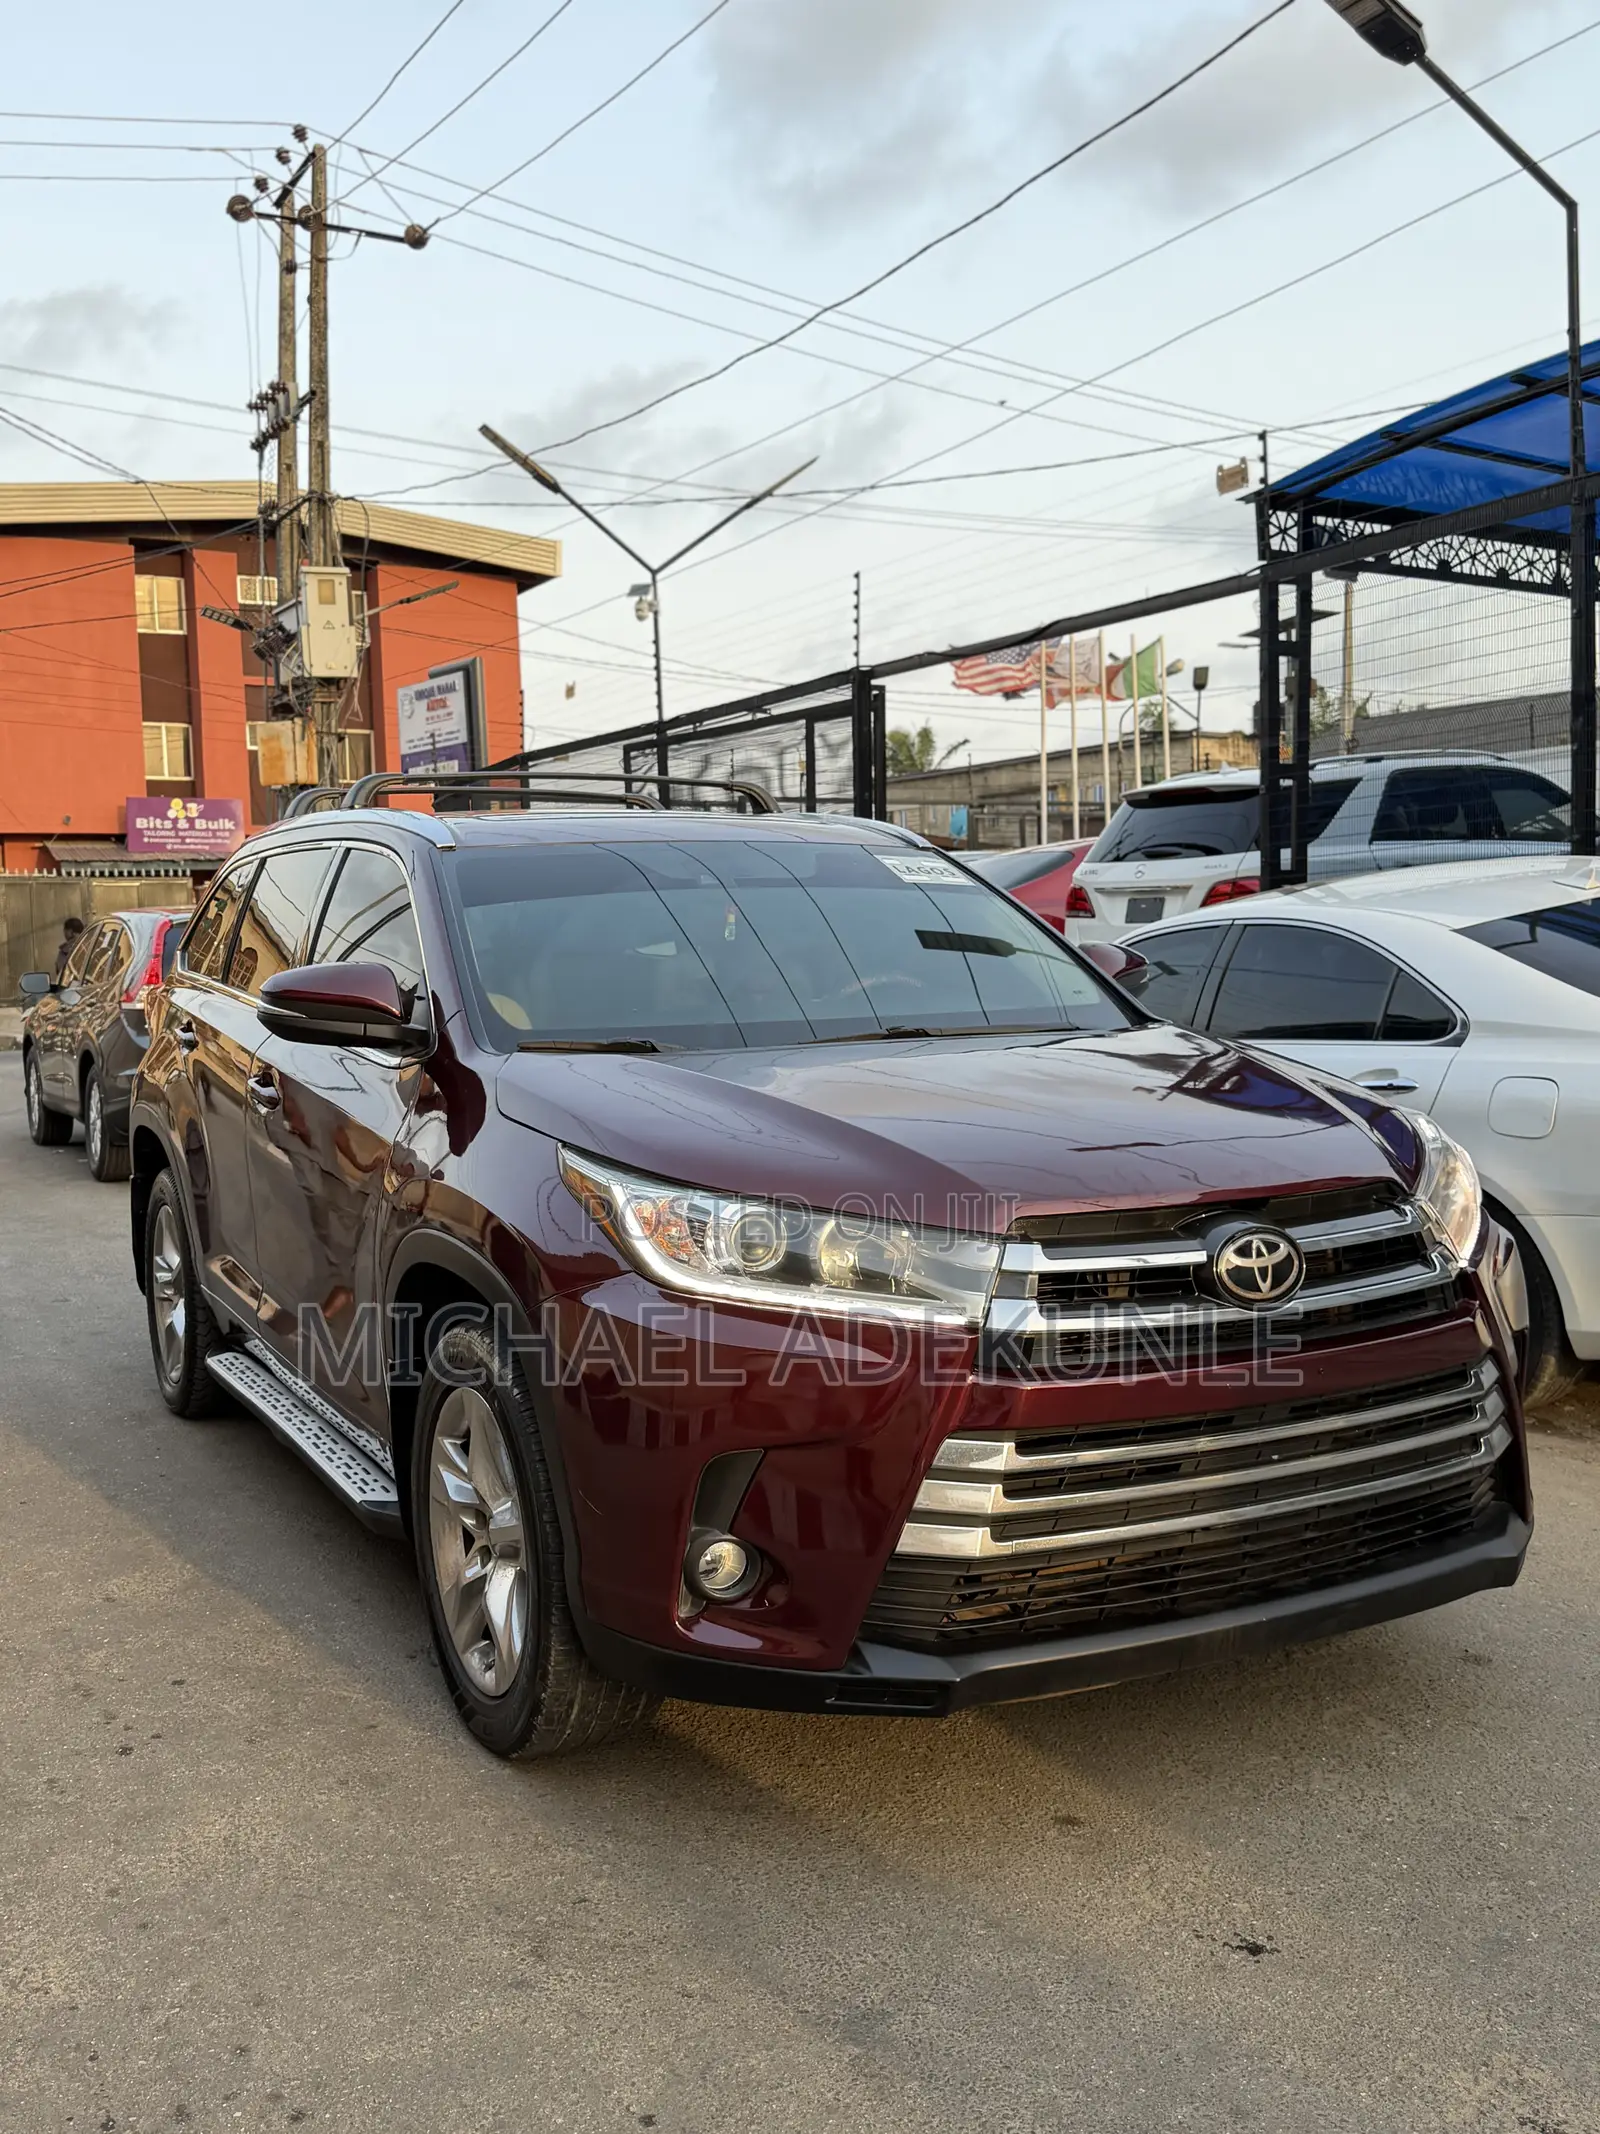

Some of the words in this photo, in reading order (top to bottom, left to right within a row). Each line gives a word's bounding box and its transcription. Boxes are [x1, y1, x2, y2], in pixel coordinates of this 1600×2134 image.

[135, 817, 173, 829] Bits
[176, 819, 189, 829] &
[195, 818, 236, 830] Bulk
[893, 865, 956, 876] LAGOS
